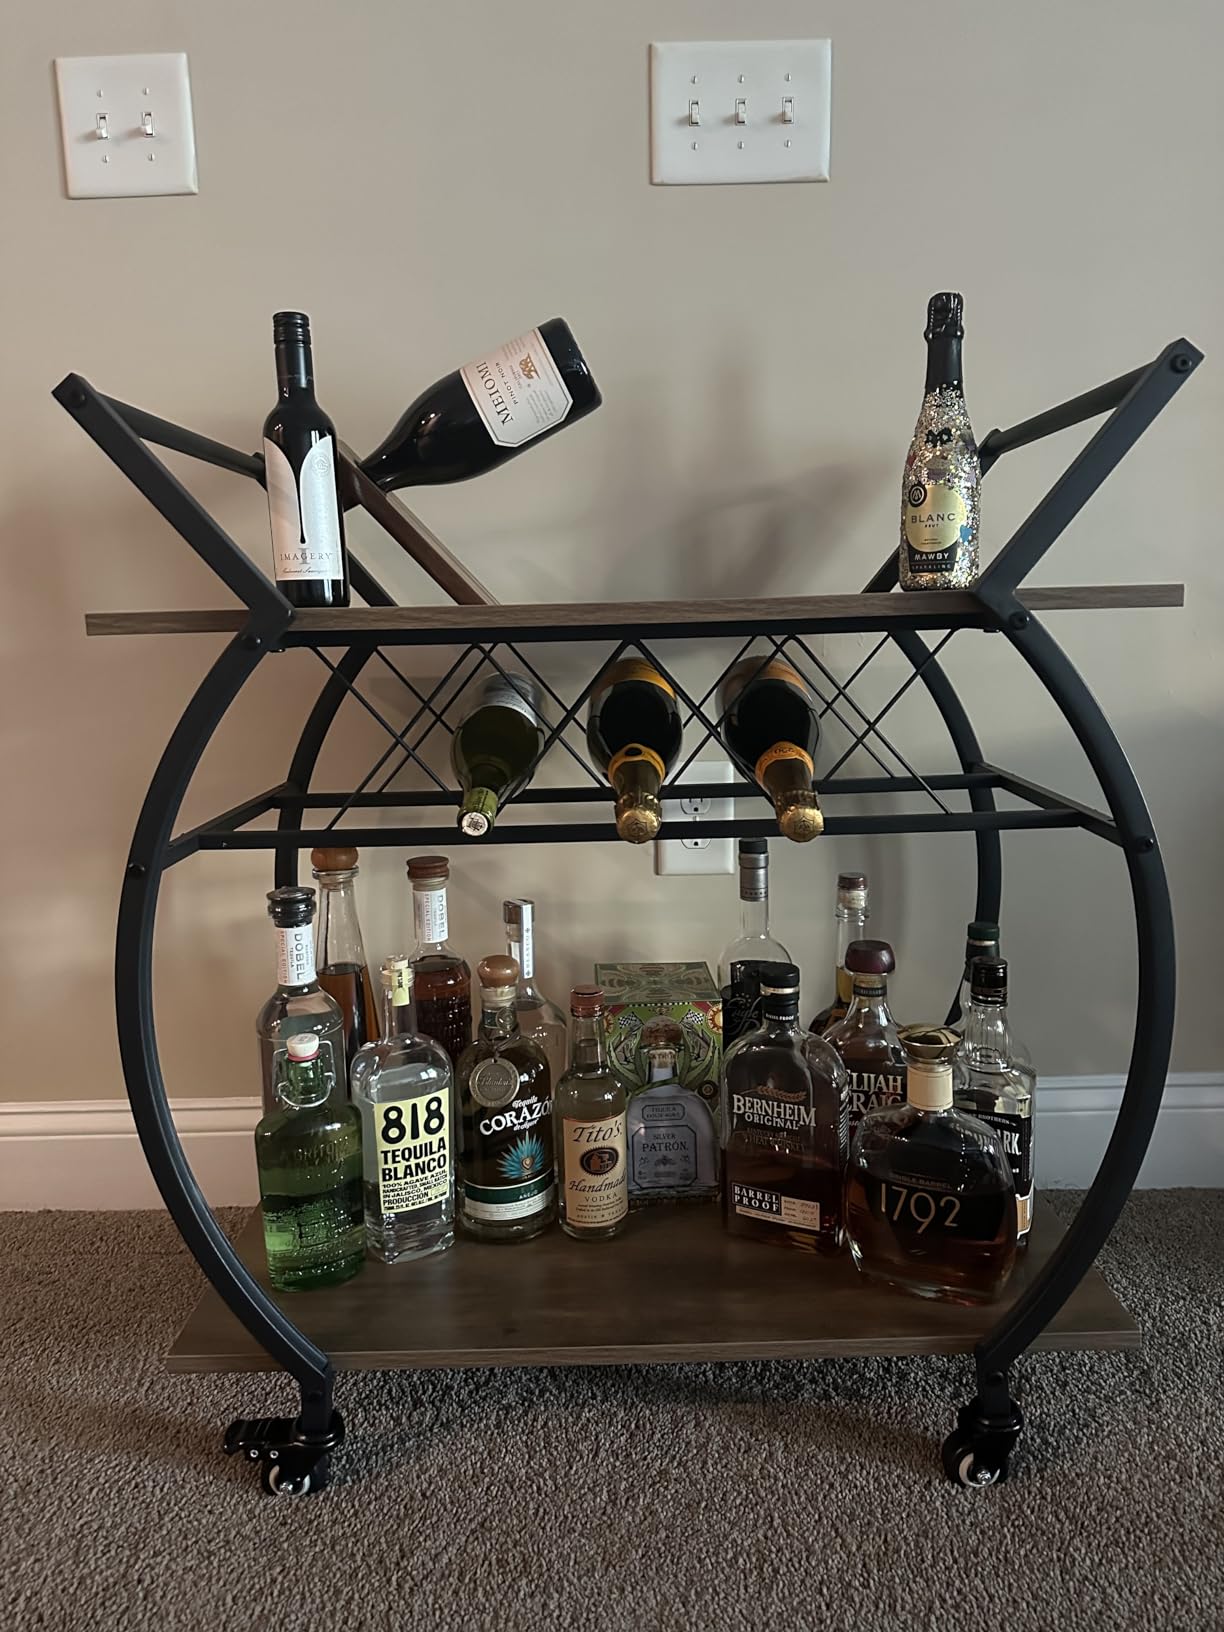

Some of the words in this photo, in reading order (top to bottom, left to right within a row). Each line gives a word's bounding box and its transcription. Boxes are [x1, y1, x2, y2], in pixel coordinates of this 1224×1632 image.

[495, 362, 506, 379] NOIR
[476, 362, 514, 425] MEIOMI
[503, 381, 519, 405] PINOT
[911, 513, 956, 524] BLANC
[280, 552, 333, 561] IMAGERY
[914, 552, 950, 561] MAWBY
[294, 933, 305, 981] DOBEL
[849, 1070, 904, 1096] LIJAH
[382, 1096, 445, 1145] 818
[732, 1093, 818, 1128] BERNHEIM
[572, 1120, 623, 1143] Tito's
[744, 1112, 799, 1131] ORIGINAL
[380, 1136, 447, 1166] TEQUILA
[382, 1153, 447, 1183] BLANCO
[382, 1181, 402, 1189] 100%
[404, 1175, 429, 1186] AGAVE
[430, 1169, 447, 1179] AZUL
[383, 1191, 429, 1206] PRODUCCIÓN
[584, 1191, 618, 1203] VODKA
[734, 1185, 779, 1204] BARREL
[734, 1194, 780, 1212] PROOF
[881, 1182, 962, 1235] 1792
